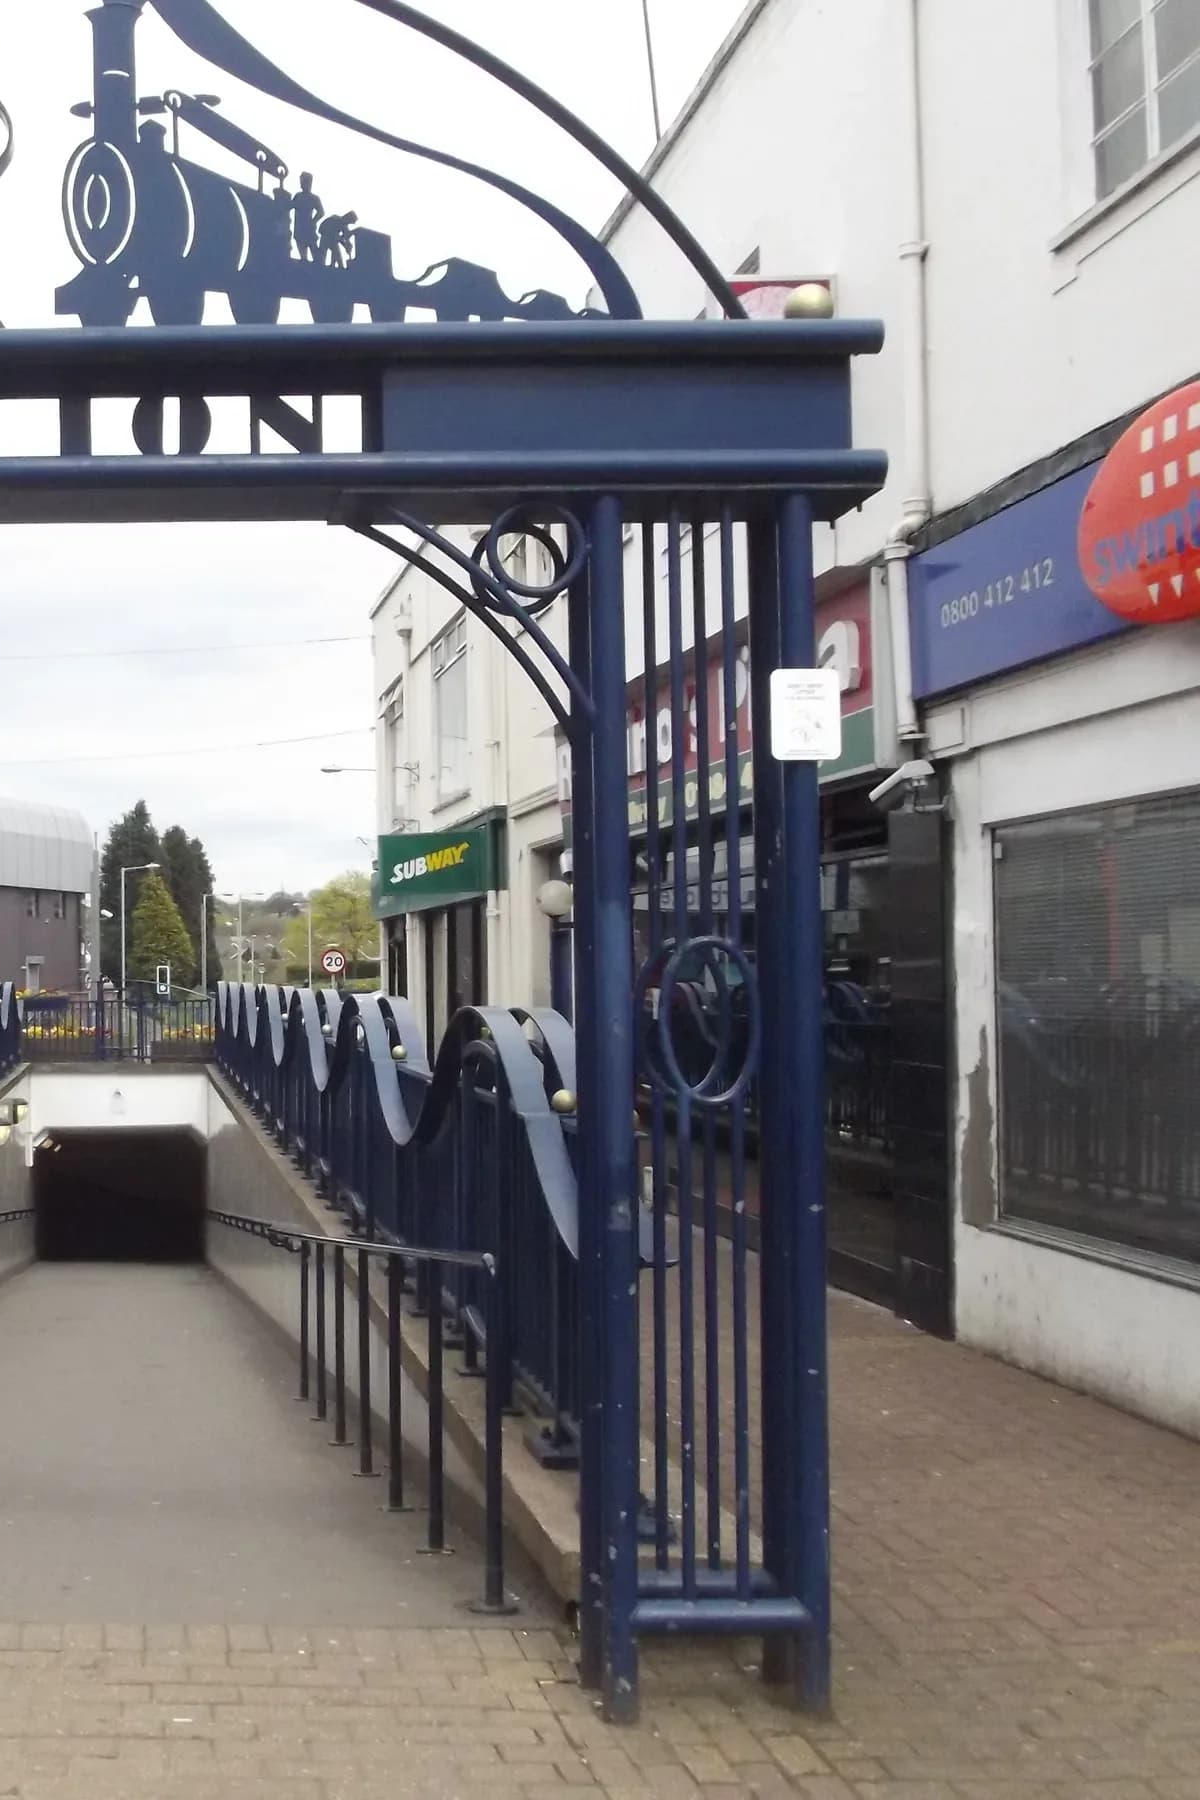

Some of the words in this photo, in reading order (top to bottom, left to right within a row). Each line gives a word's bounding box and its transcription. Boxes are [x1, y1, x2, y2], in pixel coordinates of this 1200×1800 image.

[940, 591, 979, 628] 0800
[983, 575, 1015, 609] 412
[1020, 557, 1054, 593] 412
[389, 842, 470, 884] SUBWAY
[325, 956, 343, 967] 20
